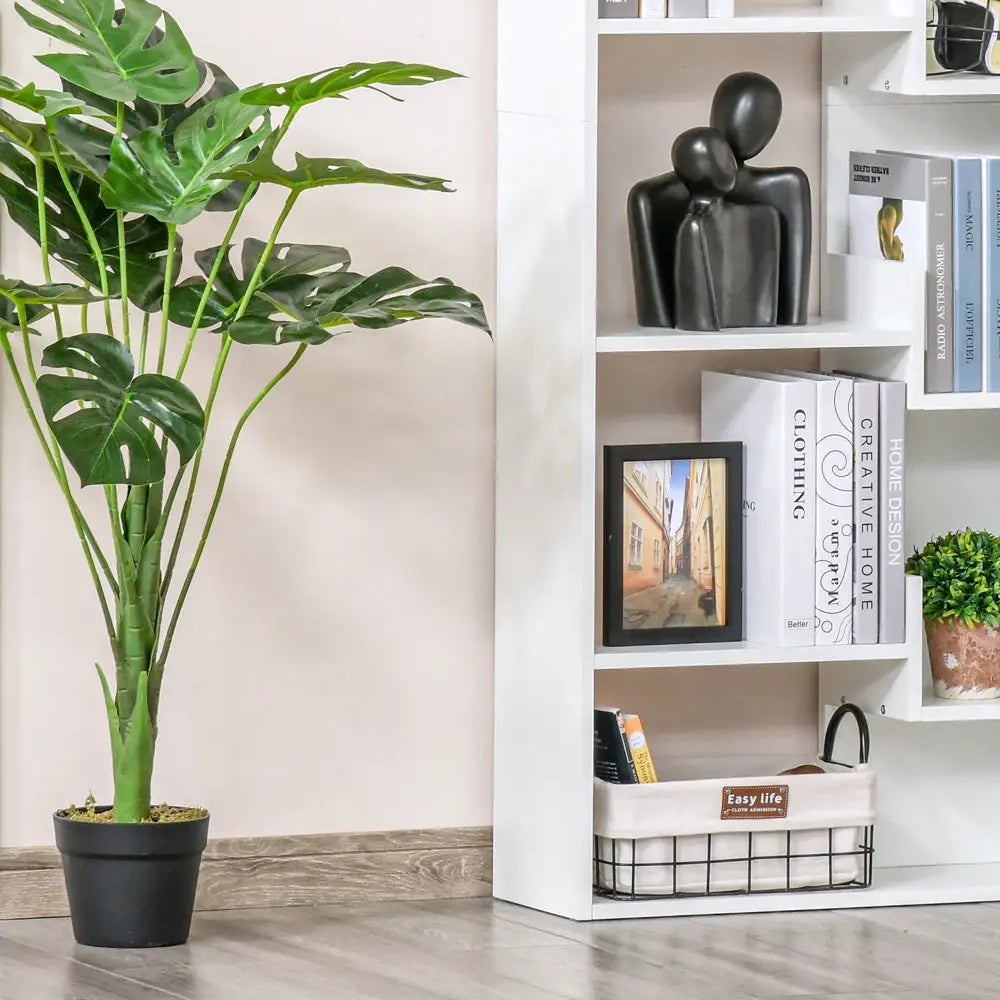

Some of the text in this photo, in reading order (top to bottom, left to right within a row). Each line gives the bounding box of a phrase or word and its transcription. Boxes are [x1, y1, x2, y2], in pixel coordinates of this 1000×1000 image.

[965, 214, 974, 252] MAGIC
[935, 242, 946, 360] RADIO ASTRONOMER
[965, 302, 975, 364] L'OFFICIEL
[793, 408, 807, 520] CLOTHING
[888, 438, 903, 493] HOME
[861, 418, 874, 611] CREATIVE HOME
[827, 518, 839, 606] Madame
[787, 620, 809, 629] Better
[637, 753, 650, 783] Synon
[727, 793, 783, 806] Easy life
